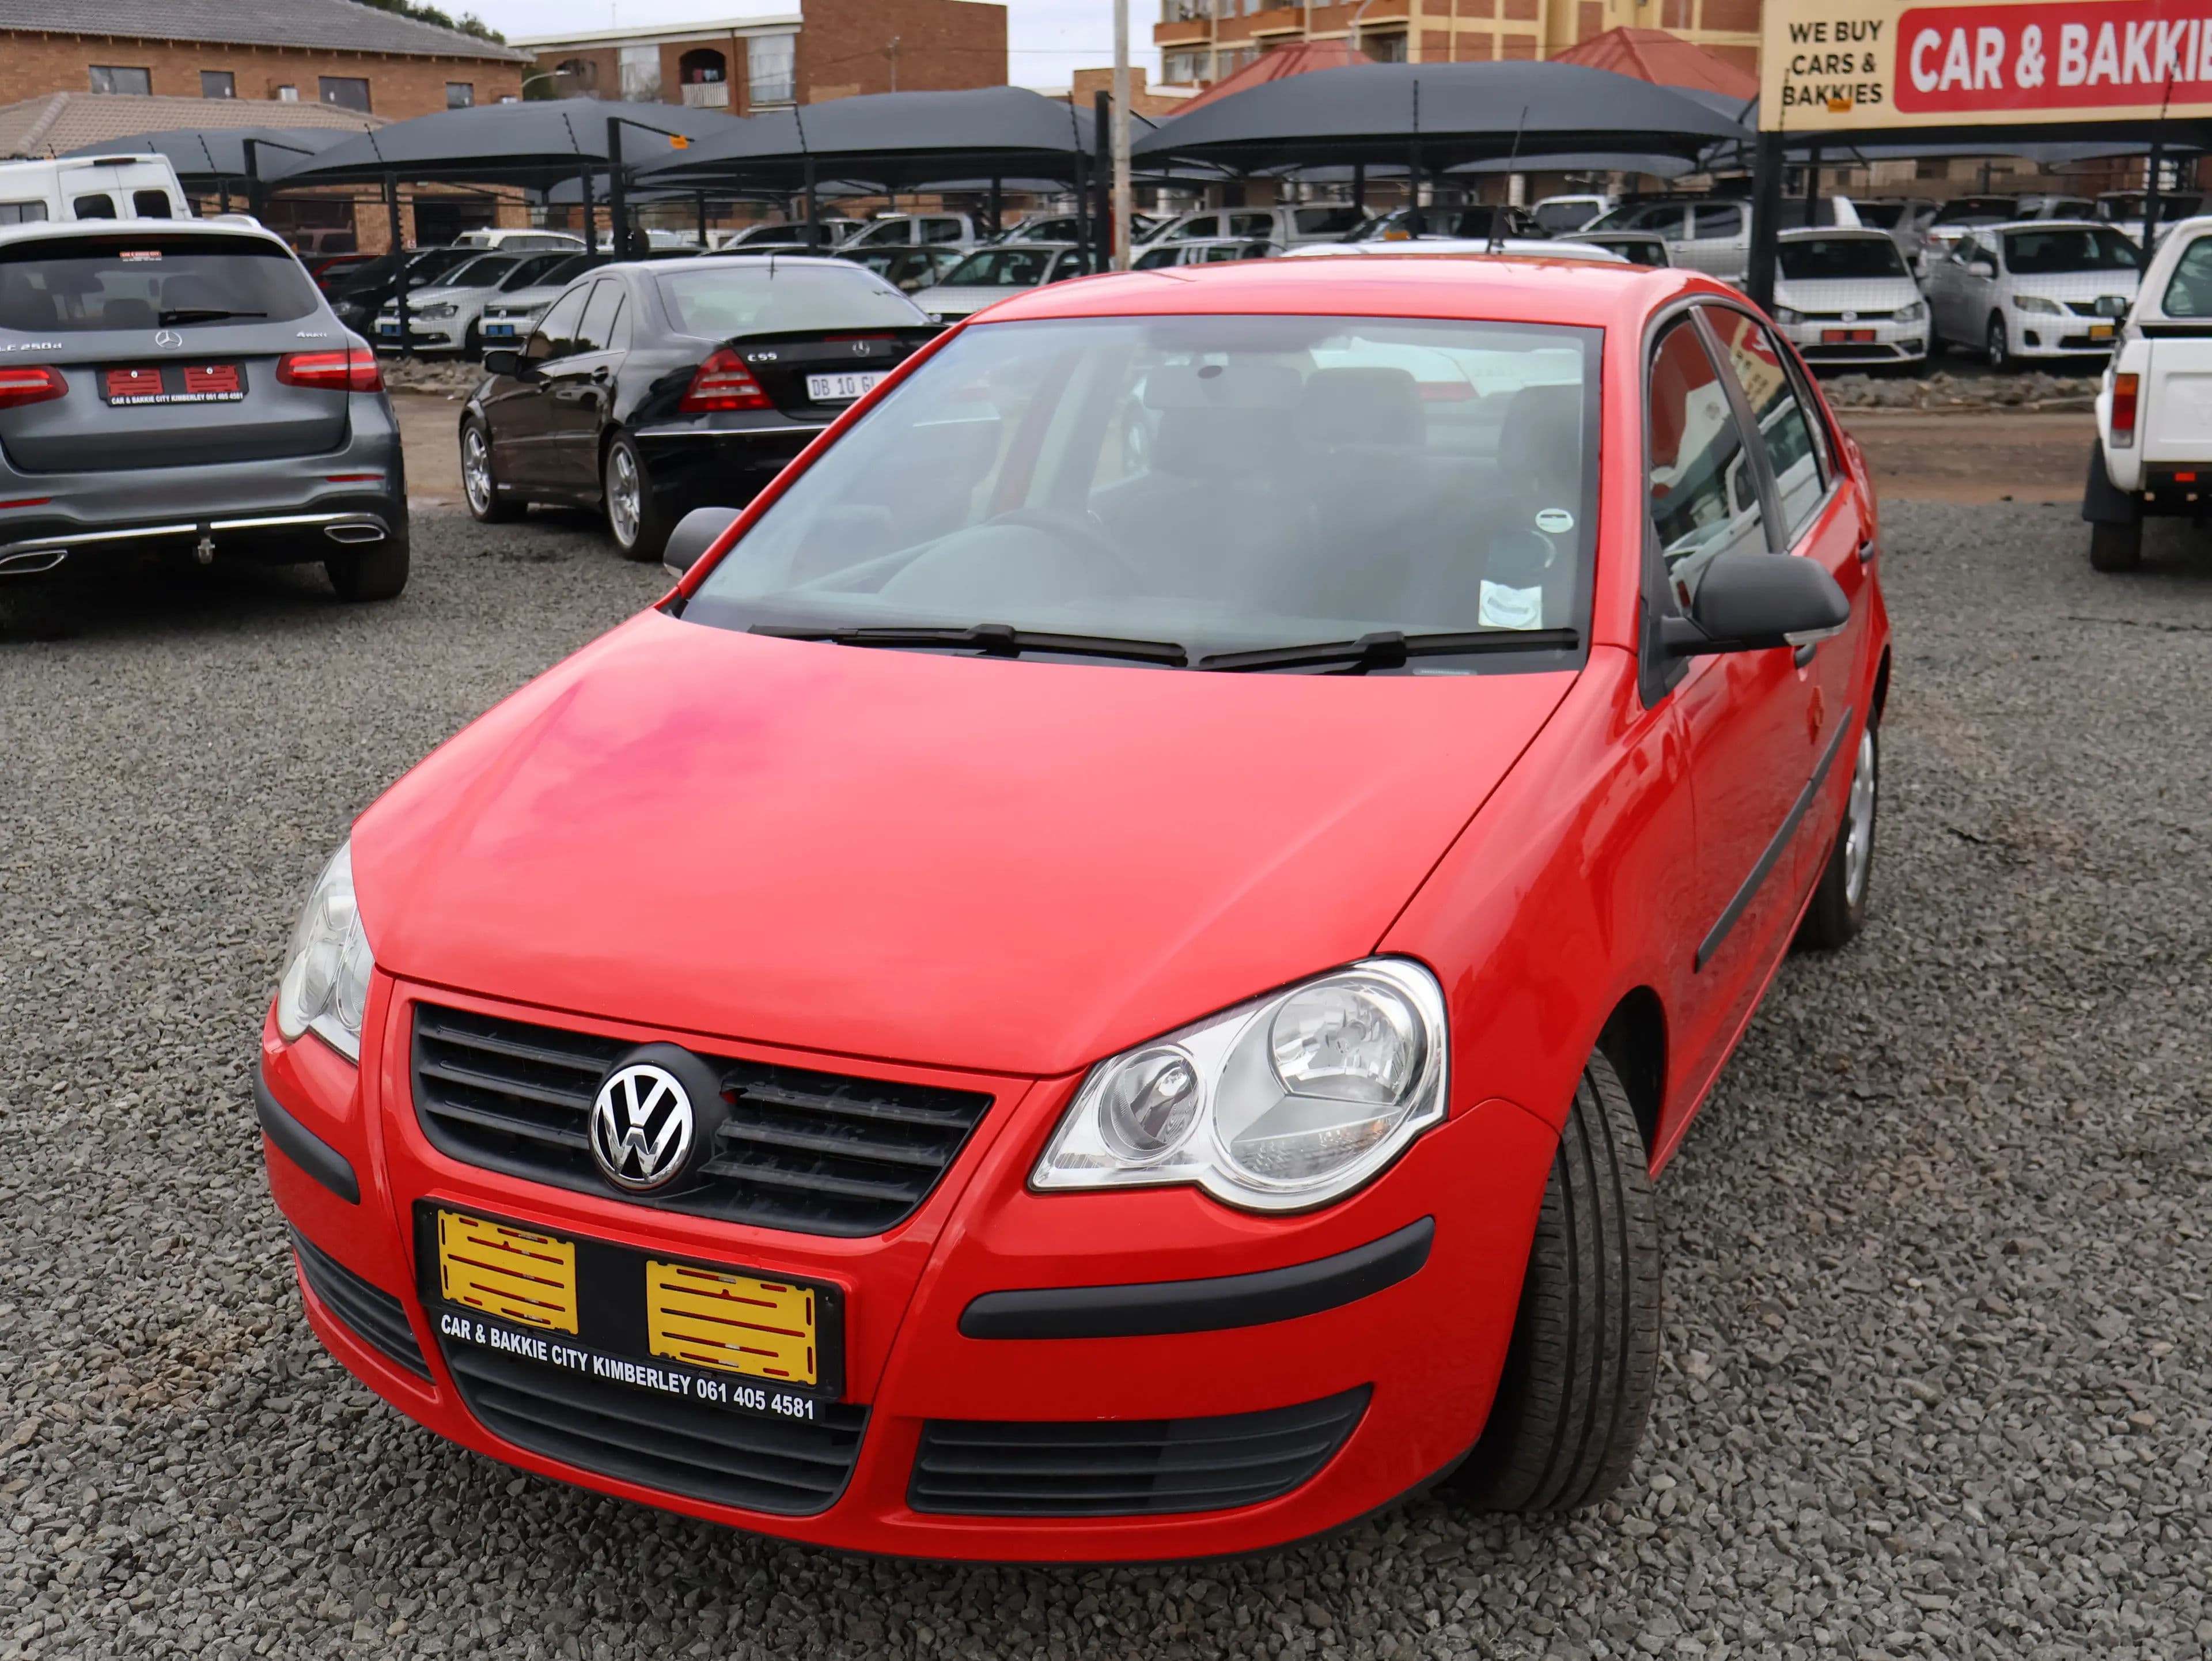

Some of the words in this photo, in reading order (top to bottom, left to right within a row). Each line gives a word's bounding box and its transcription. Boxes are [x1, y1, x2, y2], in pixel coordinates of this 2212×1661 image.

[1789, 22, 1827, 43] WE
[1835, 20, 1882, 41] BUY
[1791, 53, 1854, 75] CARS
[1862, 52, 1875, 73] &
[1910, 27, 2006, 92] CAR
[2016, 24, 2046, 89] &
[1783, 83, 1882, 106] BAKKIES
[812, 379, 830, 396] DB
[441, 1314, 471, 1341] CAR
[475, 1324, 486, 1344] &
[490, 1327, 548, 1361] BAKKIE
[551, 1345, 588, 1372] CITY
[593, 1355, 691, 1395] KIMBERLEY
[696, 1379, 727, 1403] 061
[733, 1386, 766, 1410] 405
[771, 1394, 813, 1420] 4581
